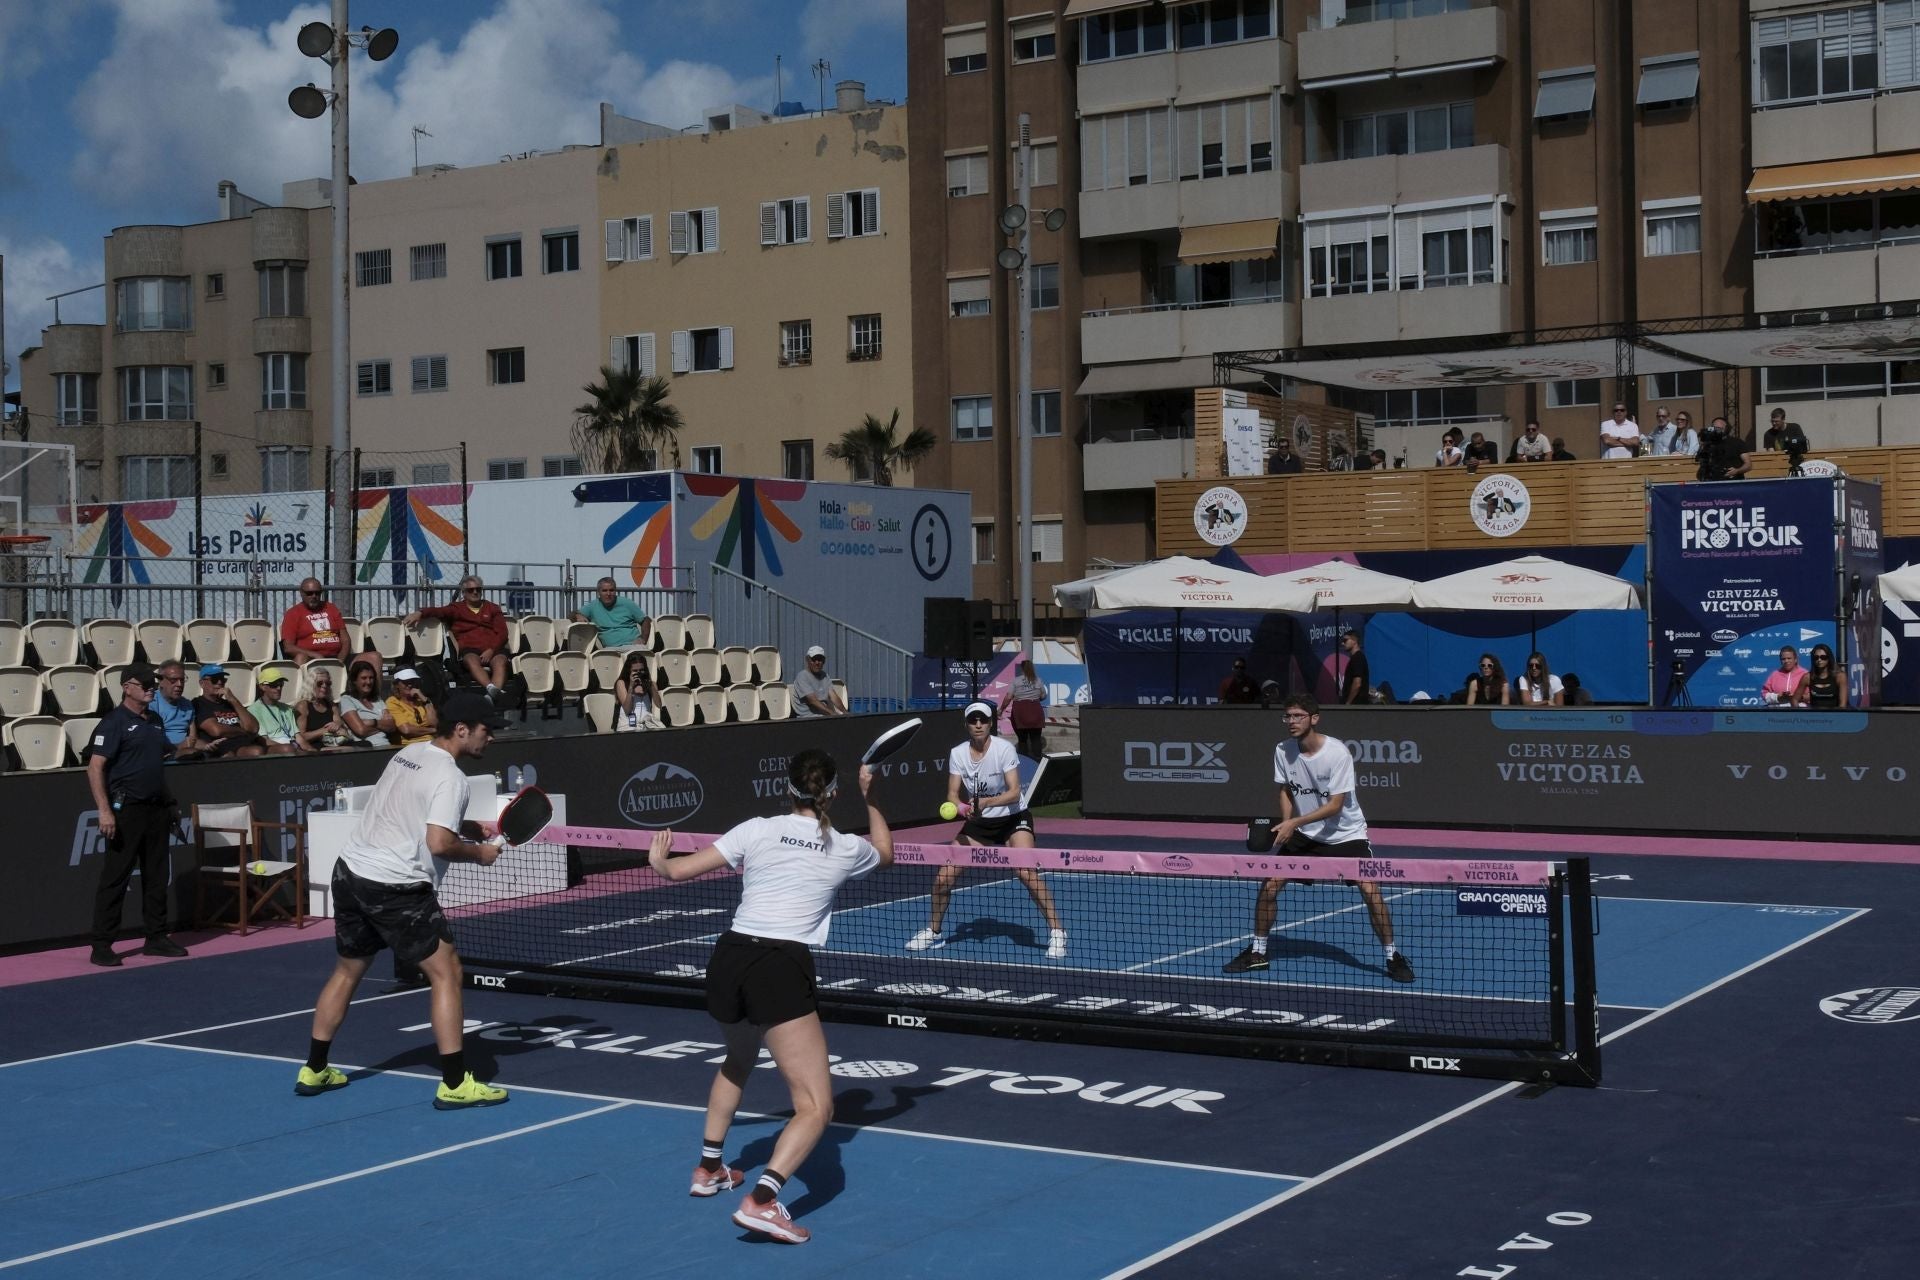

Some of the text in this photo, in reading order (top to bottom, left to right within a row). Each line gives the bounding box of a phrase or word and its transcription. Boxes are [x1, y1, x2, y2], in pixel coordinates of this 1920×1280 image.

[1479, 480, 1520, 497] VICTORIA
[1202, 492, 1238, 508] VICTORIA
[819, 500, 841, 514] Hola
[820, 516, 902, 532] Hallo Ciao Salut
[1682, 507, 1765, 529] PICKLE
[188, 529, 307, 555] Las Palmas
[1492, 595, 1544, 603] VICTORIA
[1707, 588, 1779, 598] CERVEZAS
[1700, 600, 1786, 612] VICTORIA
[1118, 629, 1172, 643] PICKLE
[1211, 628, 1255, 643] TOUR
[1608, 715, 1624, 724] 10
[1725, 715, 1735, 725] 5
[1342, 739, 1422, 763] oma
[1508, 743, 1632, 759] CERVEZAS
[881, 758, 946, 777] VOLV
[1496, 762, 1644, 784] VICTORIA
[1726, 764, 1907, 782] VOLVO
[1128, 771, 1224, 781] PICKLEBALL
[1356, 771, 1401, 788] leball
[280, 784, 319, 794] Cervezas
[626, 788, 698, 813] ASTURIANA
[566, 832, 613, 841] VOLVO
[894, 852, 925, 862] CTORIA
[971, 848, 998, 857] PICKLE
[1073, 854, 1104, 865] picklebull
[1359, 860, 1392, 870] PICKLE
[1246, 862, 1311, 871] VOLVO
[1468, 862, 1515, 870] CERVEZAS
[1464, 871, 1520, 881] VICTORIA
[1459, 892, 1546, 903] GRAN CANARIA
[1501, 903, 1533, 913] OPEN
[931, 1066, 1225, 1114] TOUR
